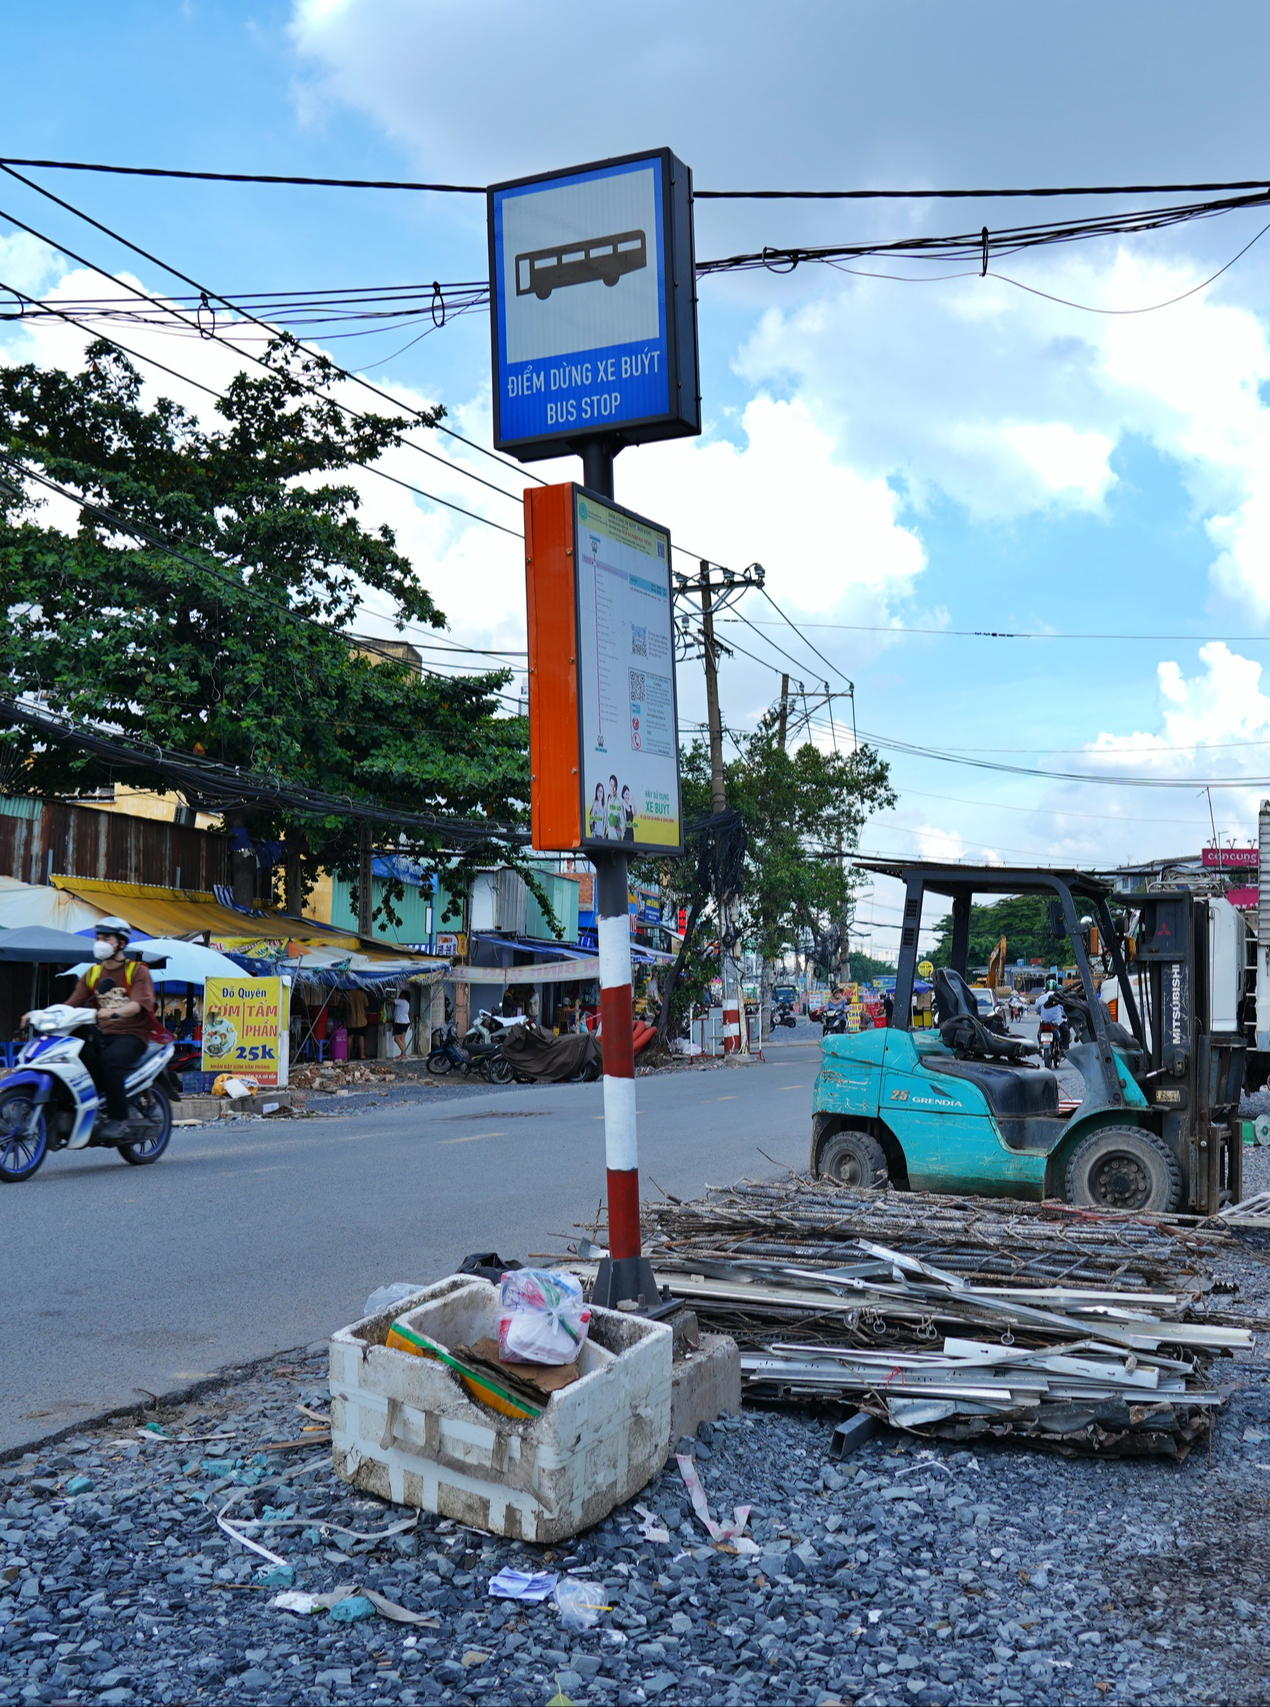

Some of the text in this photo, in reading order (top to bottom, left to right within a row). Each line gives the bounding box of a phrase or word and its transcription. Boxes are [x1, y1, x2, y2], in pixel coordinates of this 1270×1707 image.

[507, 347, 661, 398] ĐIỂM DỪNG XE BUÝT
[547, 392, 621, 425] BUS STOP
[645, 801, 670, 815] XE BUÝT
[222, 985, 267, 999] Đỗ Quyên
[247, 1000, 278, 1017] TẤM
[1172, 964, 1181, 1045] MITSUBISHI
[245, 1019, 278, 1037] PHẦN
[235, 1044, 275, 1061] 25k
[890, 1089, 963, 1107] 25 GRENDIA
